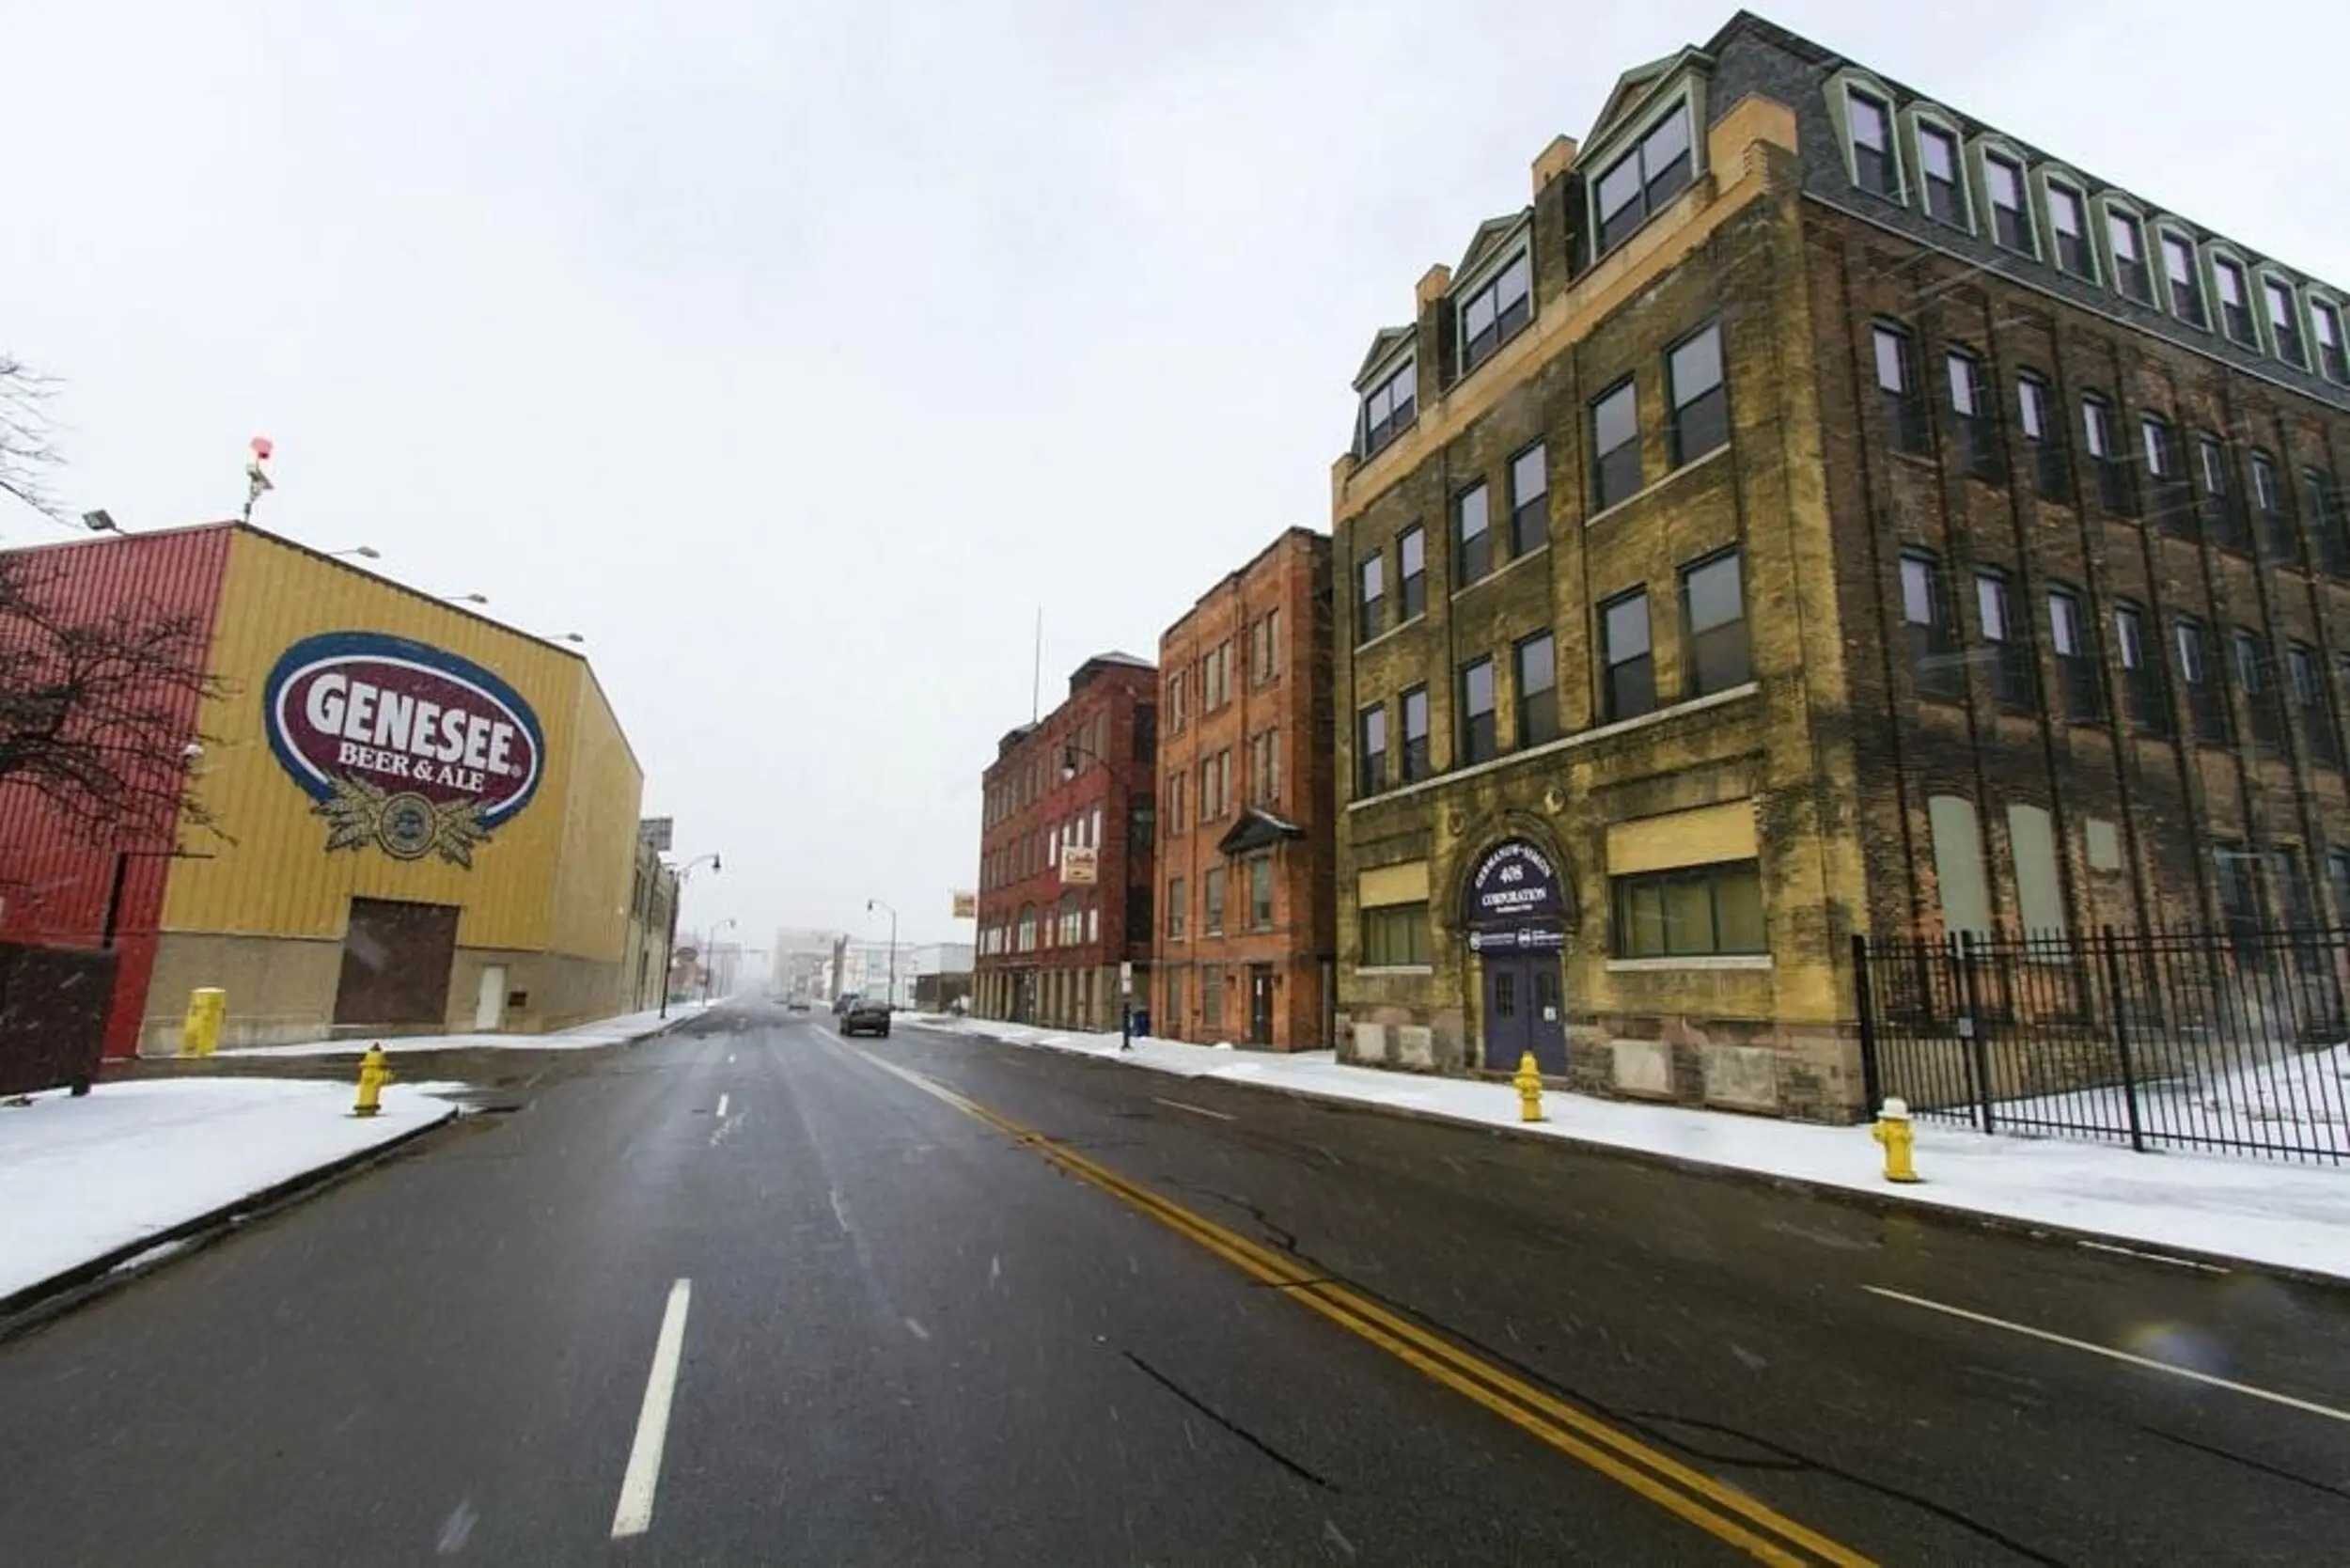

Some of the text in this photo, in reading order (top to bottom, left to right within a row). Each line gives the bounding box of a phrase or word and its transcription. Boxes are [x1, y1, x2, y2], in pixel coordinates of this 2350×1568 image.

[306, 673, 514, 776] GENESEE
[337, 742, 485, 793] BEER & ALE
[1481, 886, 1547, 906] CORPORATION
